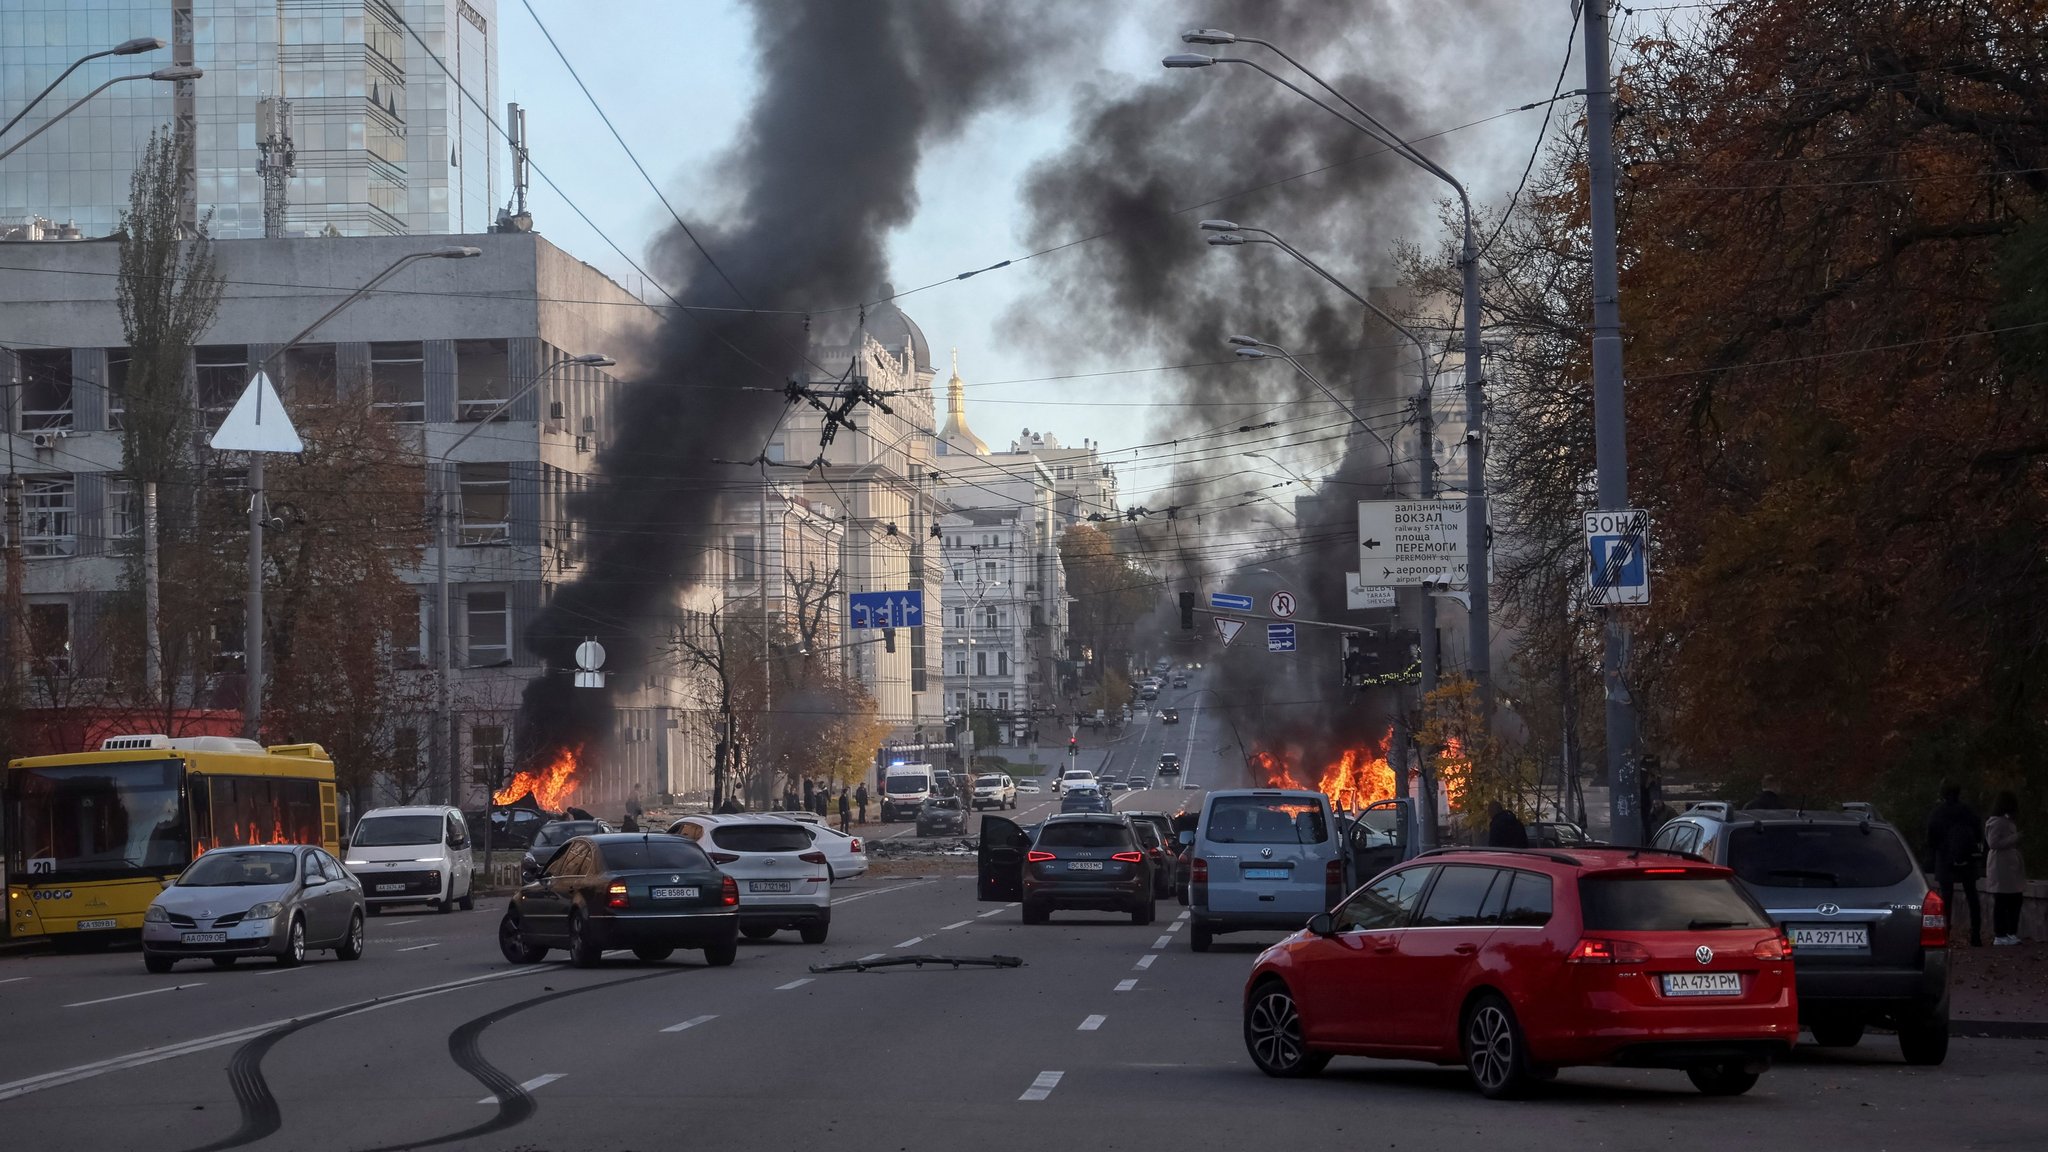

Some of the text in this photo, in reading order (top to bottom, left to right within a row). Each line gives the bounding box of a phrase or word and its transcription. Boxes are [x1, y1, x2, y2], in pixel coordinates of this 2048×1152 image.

[1395, 501, 1461, 512] залізничний
[1395, 513, 1442, 523] ВОКЗАЛ
[1425, 523, 1458, 531] STATION
[1395, 534, 1430, 542] площа
[1395, 542, 1457, 552] ПЕРЕМОГИ
[1395, 553, 1437, 562] PEREMOHY
[1396, 566, 1447, 576] аеропорт
[33, 861, 51, 874] 20
[656, 889, 695, 897] BE 8588 CI
[196, 934, 213, 942] 0709
[1796, 931, 1864, 943] AA 2971 HX
[1672, 975, 1738, 989] AA 4731 PM
